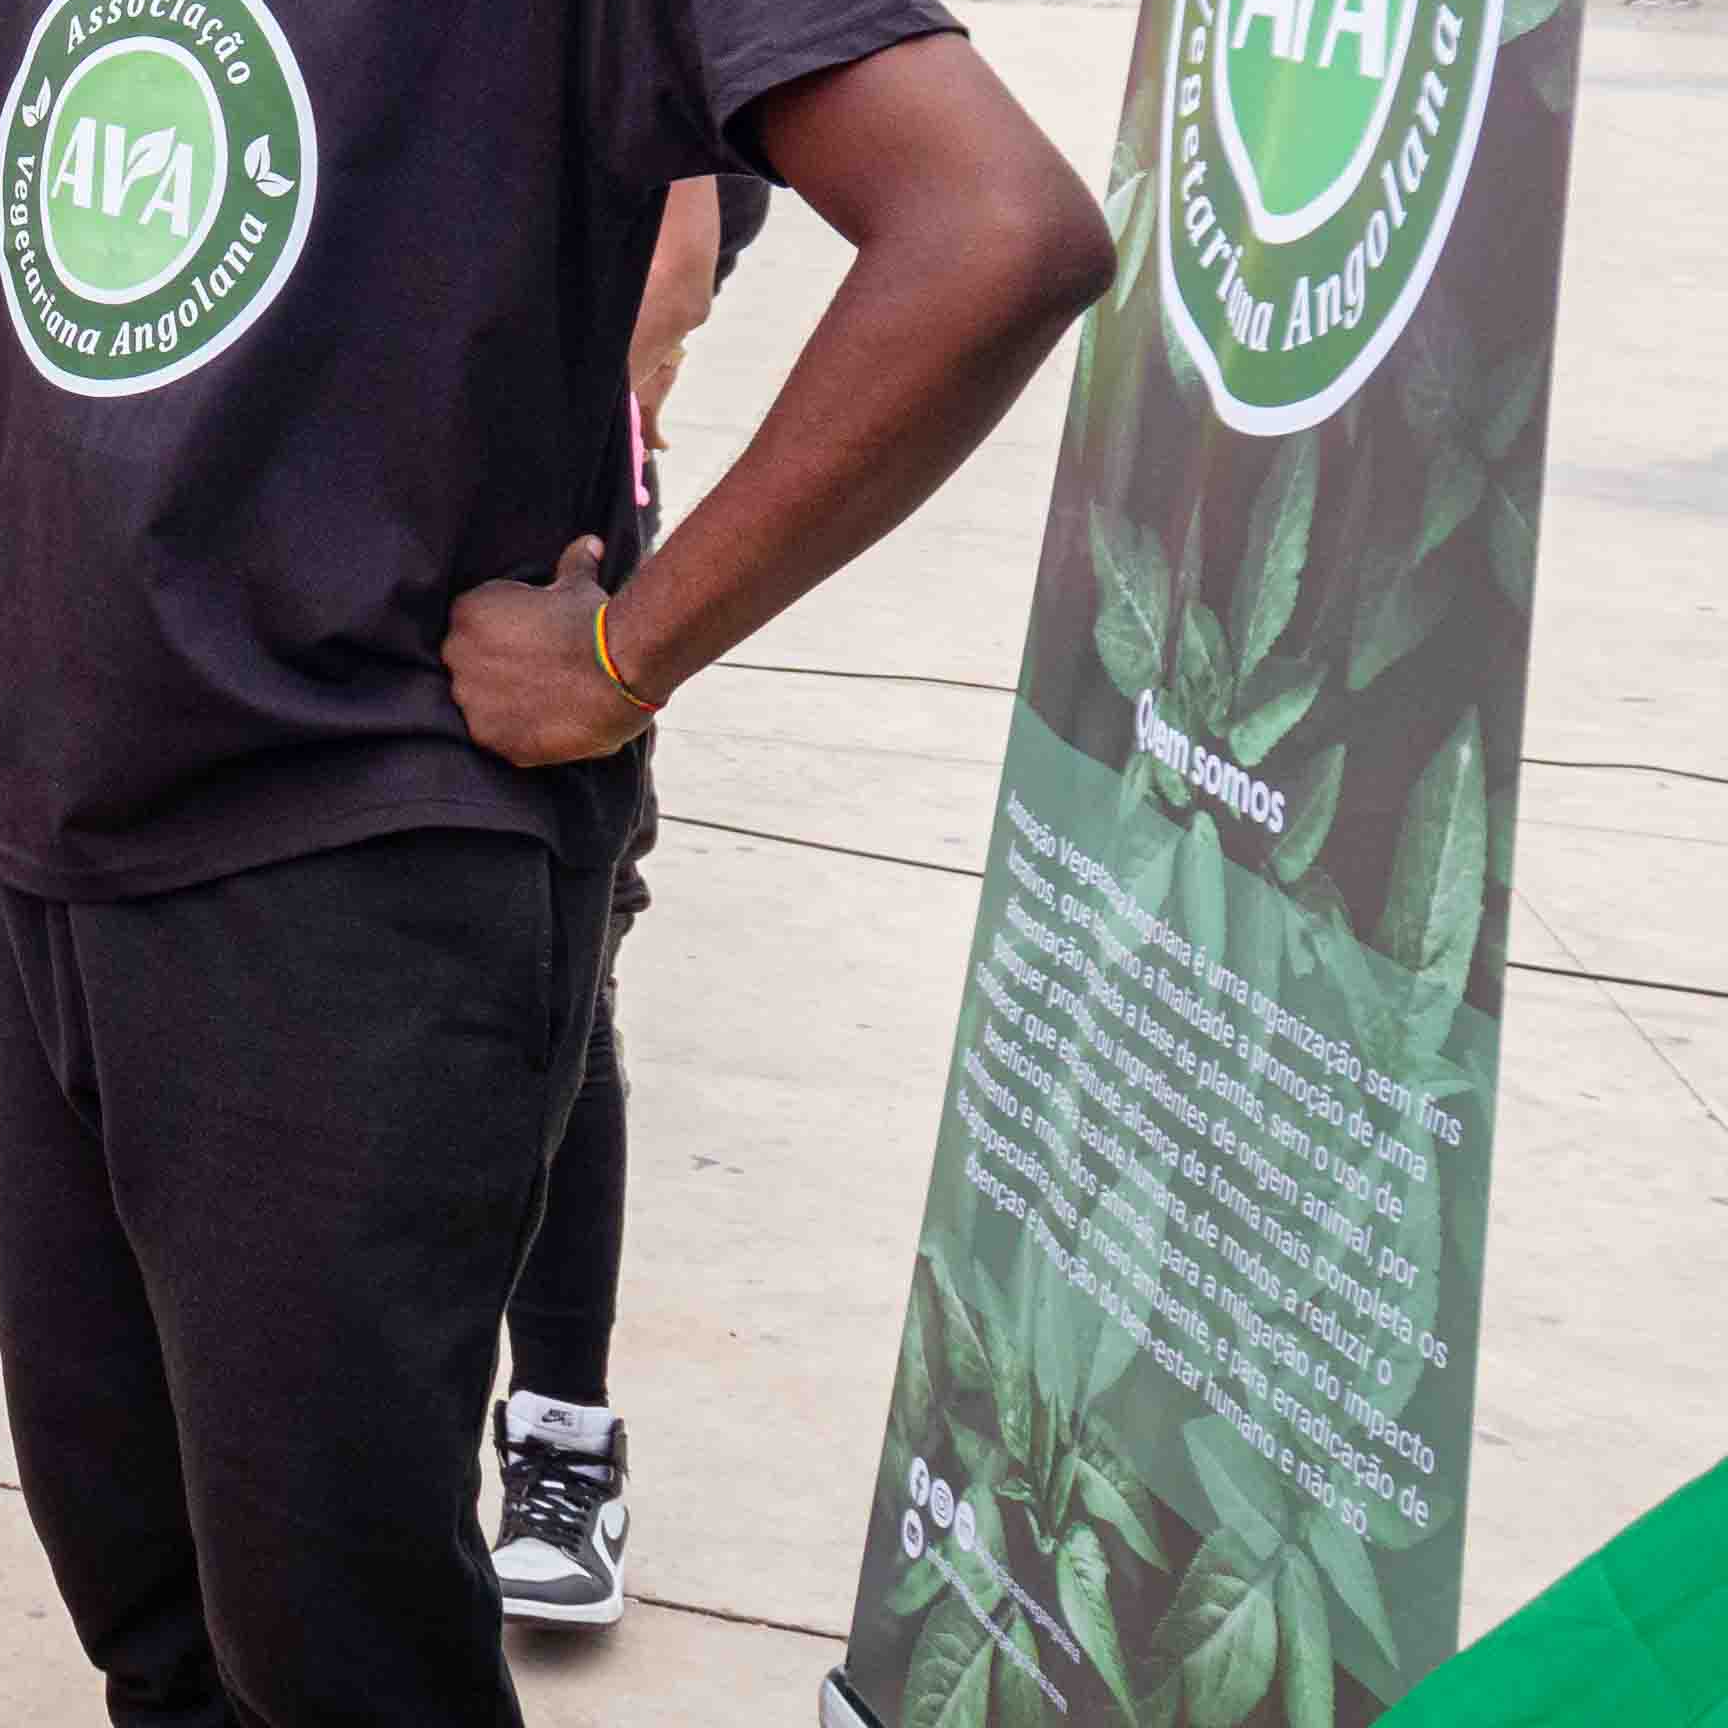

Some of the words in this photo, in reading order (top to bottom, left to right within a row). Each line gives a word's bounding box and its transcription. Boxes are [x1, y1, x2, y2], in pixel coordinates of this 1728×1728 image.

[9, 154, 100, 356] Vegetariana
[109, 212, 267, 358] Angolana
[50, 116, 193, 238] AVA
[1282, 4, 1463, 351] Angolana
[1191, 744, 1286, 833] somos
[1060, 893, 1092, 929] que
[1156, 968, 1235, 1049] finalidade
[1236, 1033, 1249, 1059] a
[1250, 1043, 1344, 1125] promoção
[1348, 1106, 1374, 1148] de
[1376, 1132, 1428, 1183] uma
[1139, 1004, 1176, 1057] base
[1176, 1039, 1198, 1074] de
[1198, 1059, 1266, 1133] plantas,
[1269, 1114, 1311, 1160] sem
[1314, 1145, 1328, 1172] o
[1332, 1157, 1370, 1200] uso
[1375, 1183, 1403, 1222] de
[1192, 945, 1207, 976] é
[1206, 961, 1249, 1004] uma
[1250, 991, 1361, 1084] organização
[1364, 1069, 1412, 1116] sem
[1417, 1092, 1463, 1146] fins
[1024, 1013, 1057, 1052] que
[1181, 1148, 1206, 1186] de
[1209, 1164, 1261, 1231] forma
[1263, 1216, 1312, 1268] mais
[1314, 1255, 1413, 1344] completa
[1419, 1330, 1449, 1369] os
[1114, 1039, 1208, 1135] ingredientes
[1211, 1118, 1236, 1155] de
[1239, 1142, 1298, 1206] origem
[1302, 1192, 1373, 1267] animal,
[1378, 1246, 1419, 1289] por
[1021, 1104, 1033, 1129] e
[1160, 1240, 1201, 1287] para
[1202, 1274, 1217, 1300] a
[1220, 1287, 1310, 1377] mitigação
[1313, 1359, 1340, 1401] do
[1344, 1381, 1435, 1474] impacto
[1193, 1211, 1219, 1248] de
[1221, 1233, 1281, 1301] modos
[1283, 1287, 1297, 1314] a
[1300, 1299, 1374, 1370] reduzir
[1377, 1359, 1392, 1385] o
[1203, 1372, 1276, 1459] humano
[1280, 1448, 1294, 1474] e
[1296, 1460, 1336, 1509] não
[1340, 1498, 1373, 1543] só.
[1216, 1337, 1229, 1361] e
[1230, 1350, 1268, 1400] para
[1273, 1386, 1394, 1499] erradicação
[1399, 1484, 1429, 1527] de
